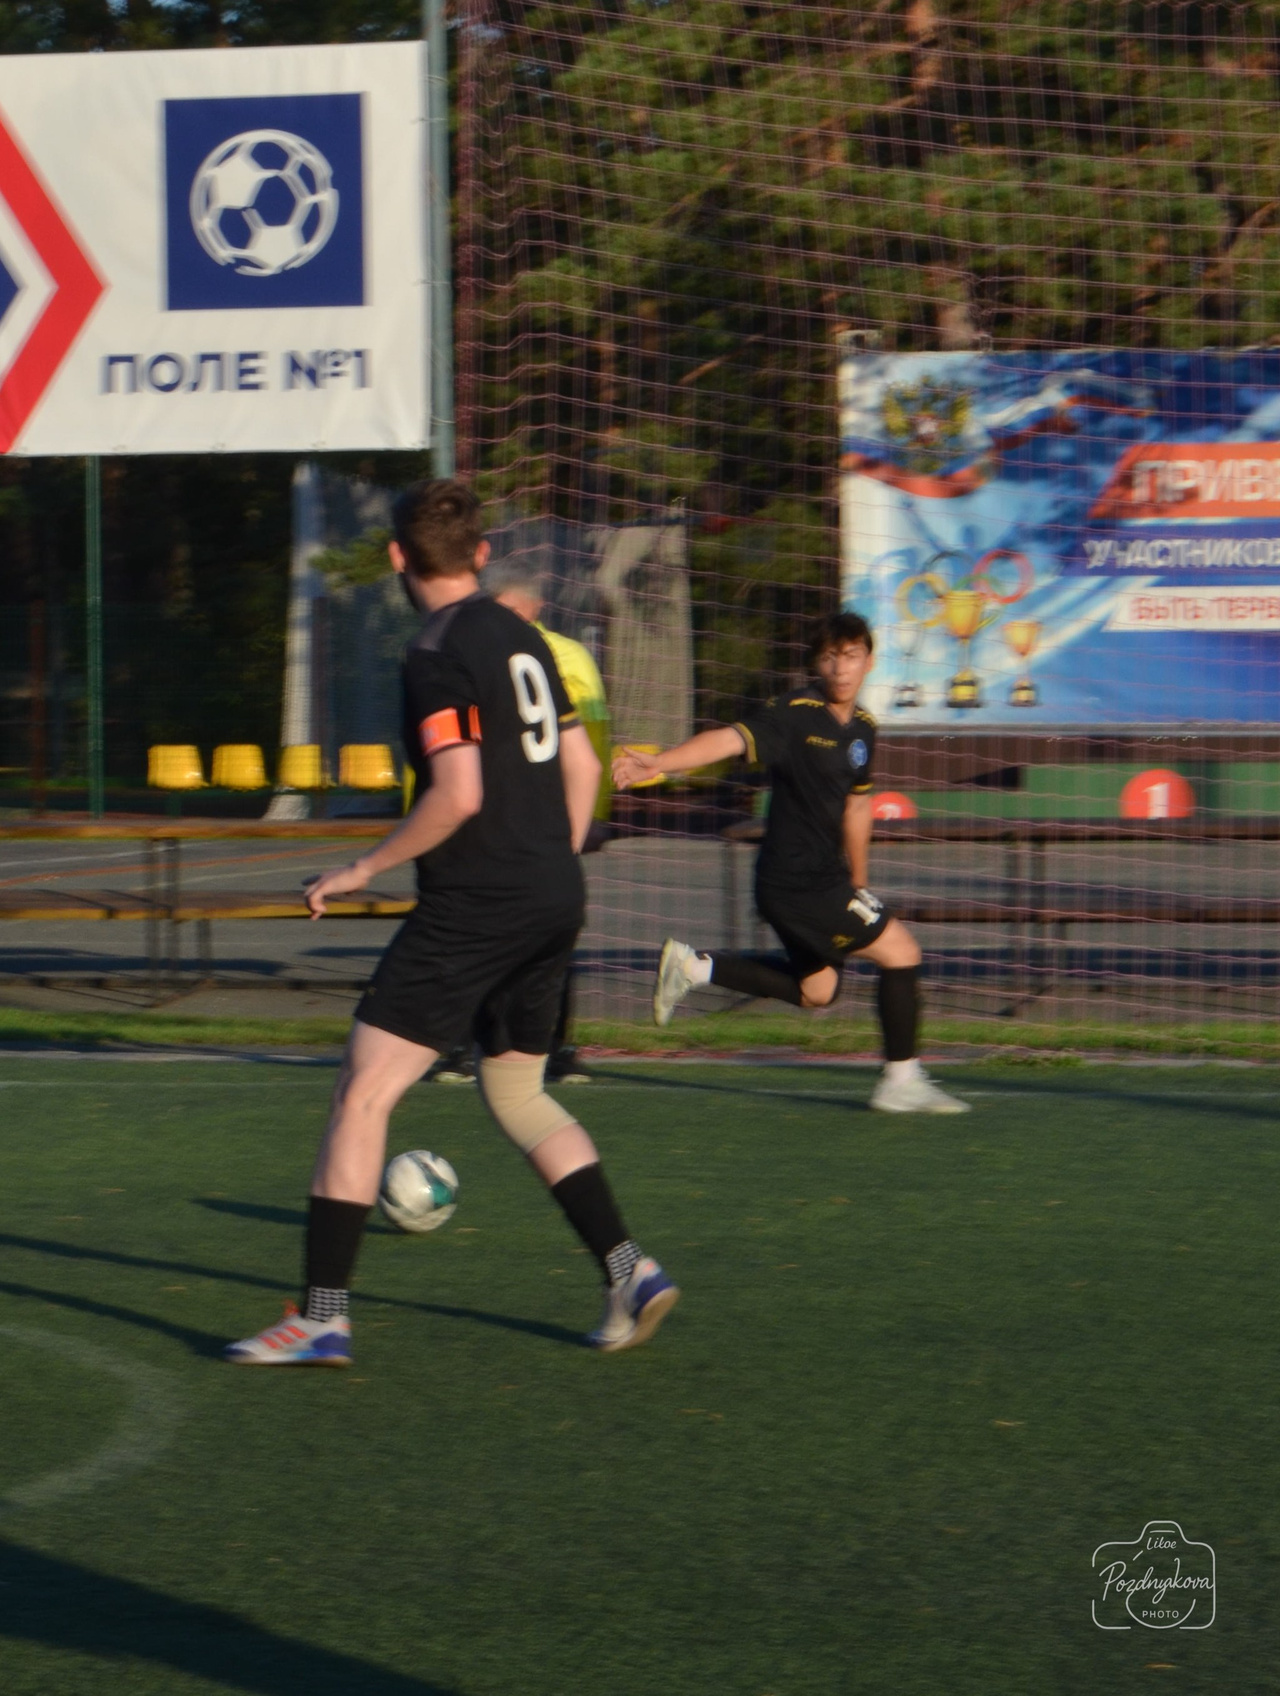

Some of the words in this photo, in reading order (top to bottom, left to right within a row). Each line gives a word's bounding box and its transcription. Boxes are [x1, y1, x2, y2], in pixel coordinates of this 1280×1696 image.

[98, 352, 269, 394] ПОЛЕ
[280, 349, 373, 391] №1
[508, 653, 559, 763] 9
[1141, 782, 1170, 820] 1
